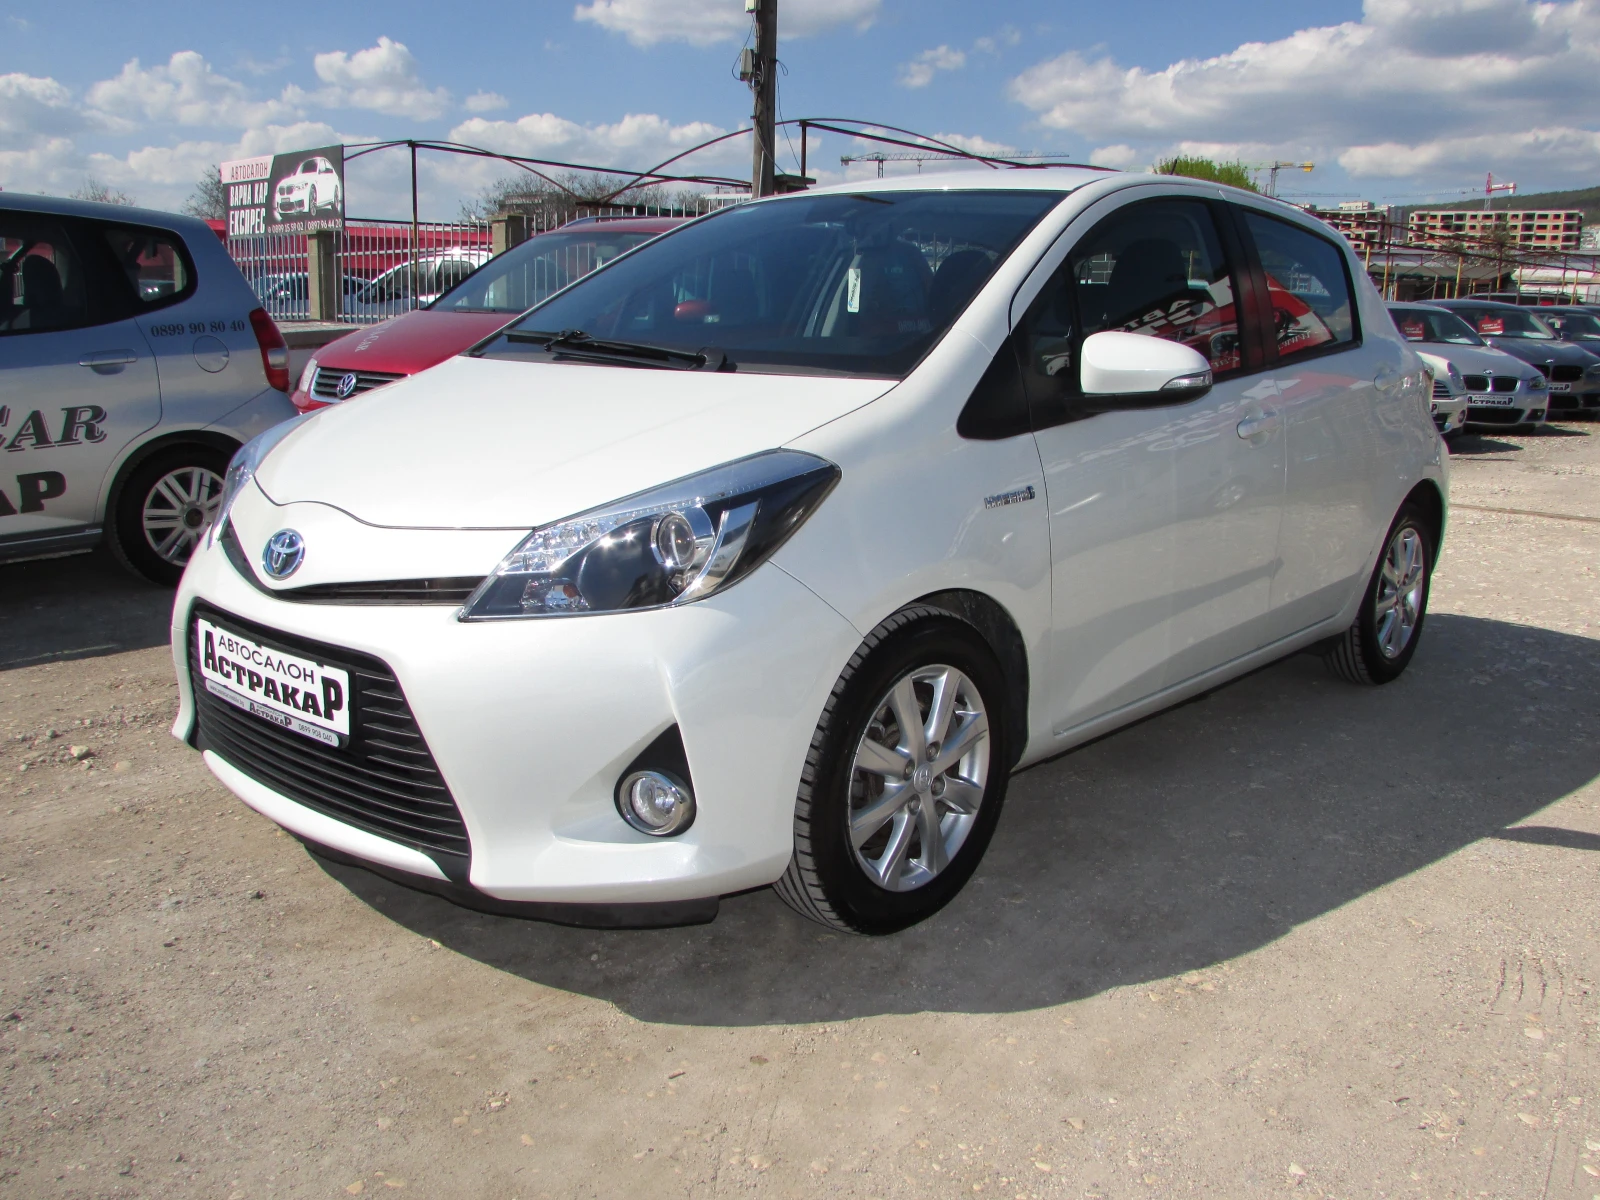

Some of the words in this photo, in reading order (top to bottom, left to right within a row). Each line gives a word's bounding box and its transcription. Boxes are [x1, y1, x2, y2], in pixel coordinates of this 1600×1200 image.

[230, 162, 269, 180] АВТОСАЛОН
[230, 184, 252, 207] ВАРНА
[254, 181, 269, 204] КАР
[229, 208, 266, 236] ЕКСПРЕС
[150, 323, 185, 338] 0899
[188, 322, 206, 335] 90
[210, 320, 226, 333] 80
[230, 319, 245, 332] 40
[218, 635, 315, 685] АВТОСАЛОН
[312, 728, 322, 739] 908
[322, 732, 333, 743] 040
